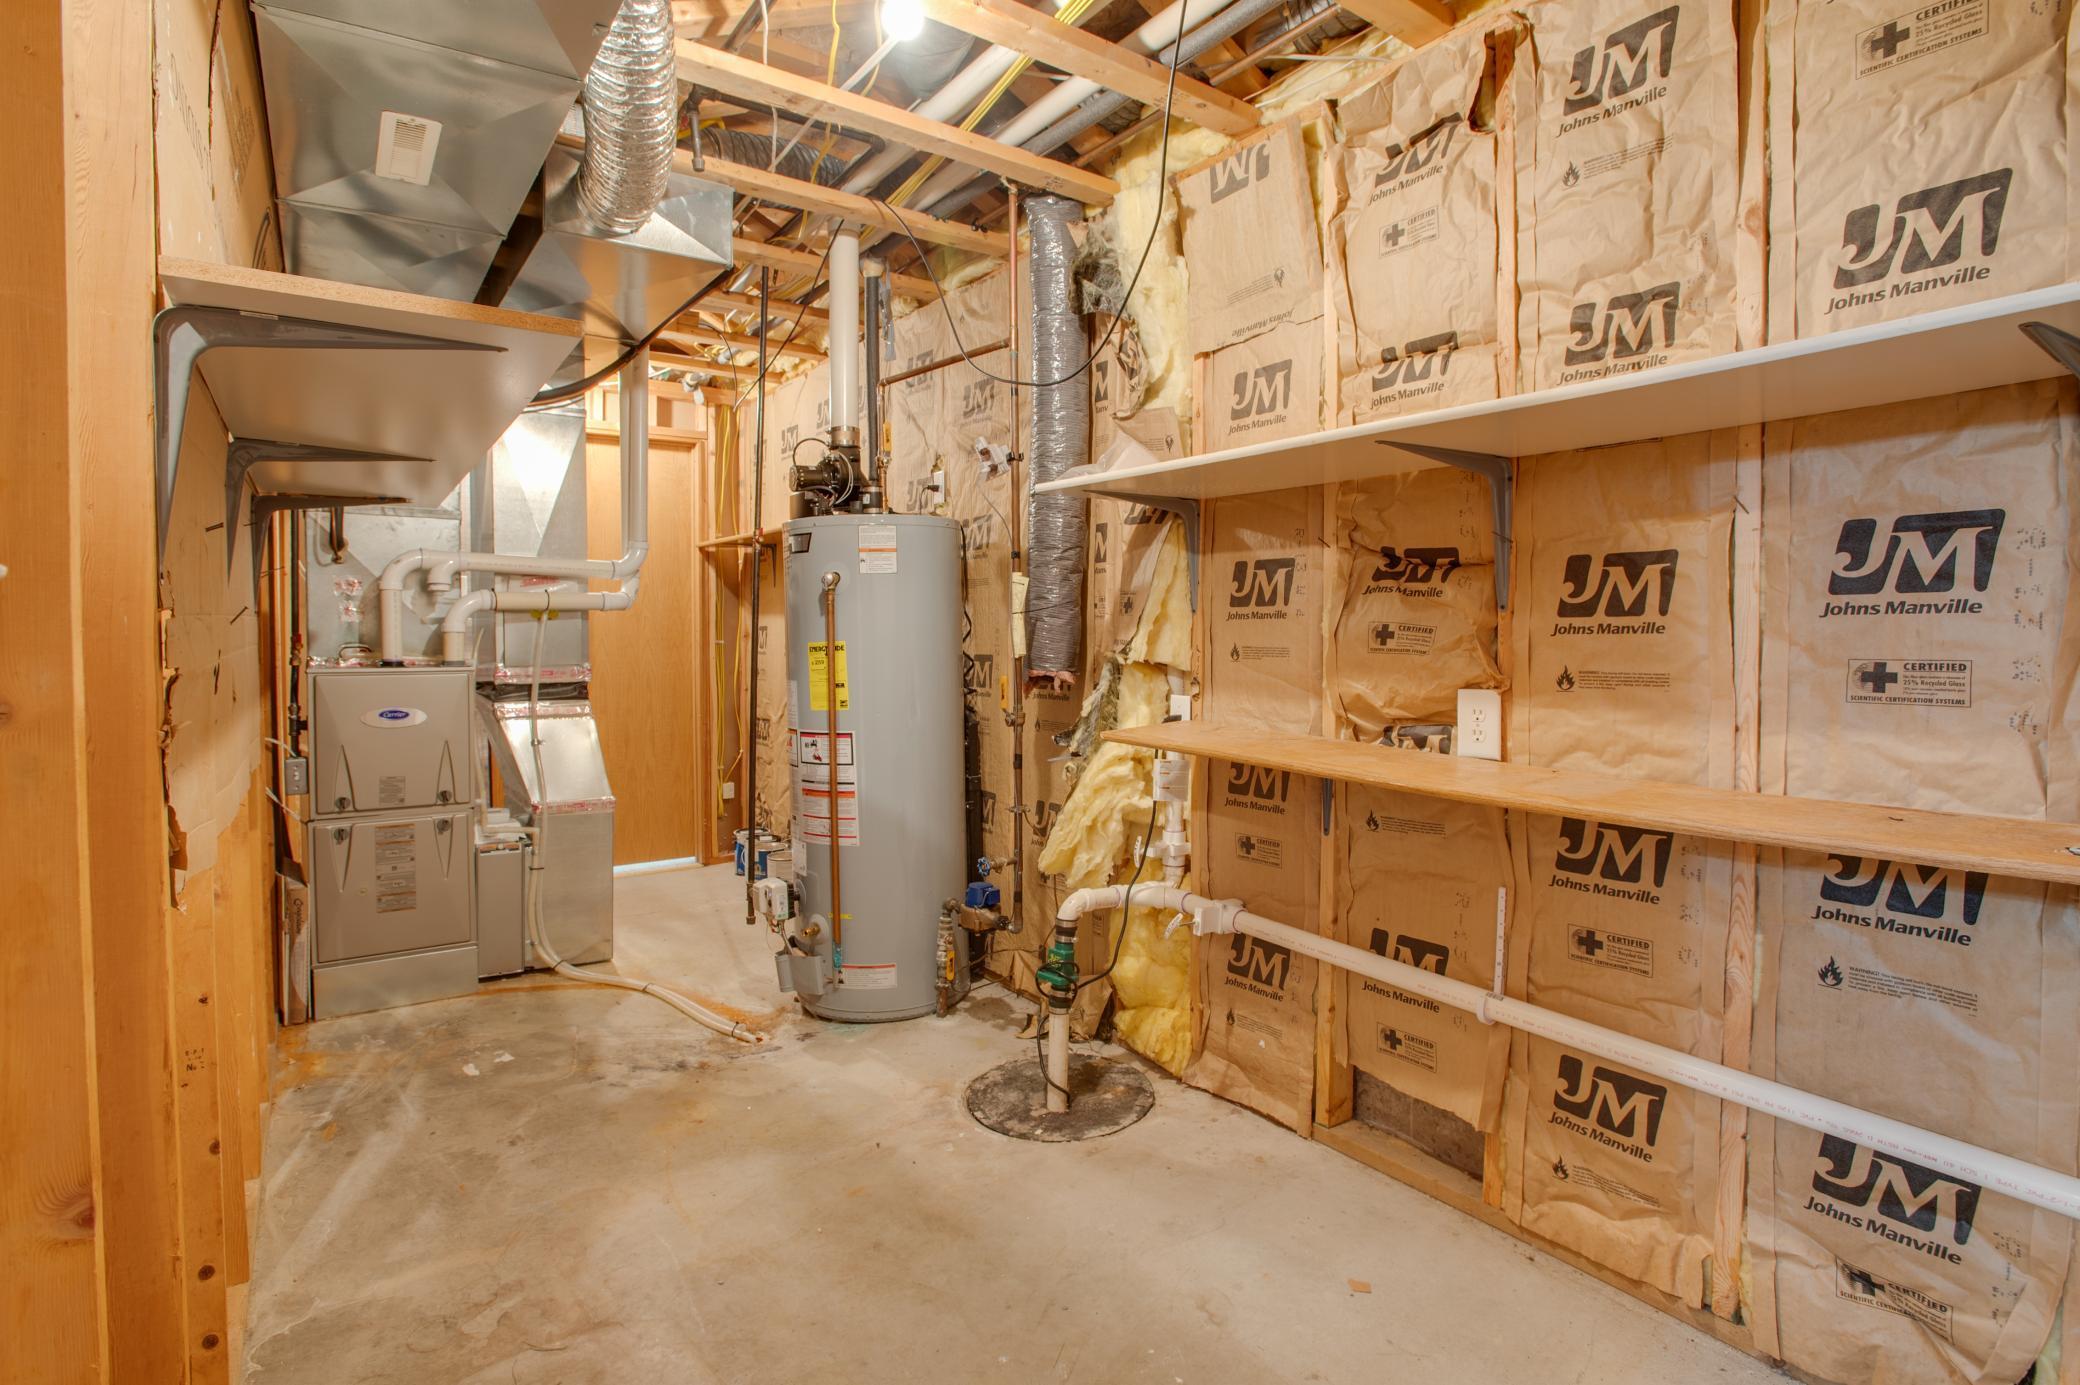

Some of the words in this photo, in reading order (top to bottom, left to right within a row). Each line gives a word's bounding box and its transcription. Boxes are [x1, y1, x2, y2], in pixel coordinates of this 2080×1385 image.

[1563, 5, 1680, 117] JM
[1860, 59, 1894, 76] SCIENTIFIC
[1896, 40, 1948, 63] CERTIFICATION
[1950, 27, 1983, 44] SYSTEMS
[1555, 112, 1601, 138] Johns
[1602, 85, 1668, 120] Manville
[1368, 184, 1397, 207] Johns
[1397, 164, 1444, 192] Manville
[1833, 168, 2013, 289] JM
[1824, 289, 1886, 315] Johns
[1889, 266, 1990, 298] Manville
[1565, 281, 1681, 366] JM
[1231, 358, 1293, 421] JM
[1557, 367, 1601, 385] Johns
[1603, 354, 1668, 377] Manville
[1368, 393, 1397, 410] Johns
[1397, 381, 1445, 402] Manville
[1228, 420, 1251, 436] Johns
[1251, 413, 1287, 430] Manville
[1828, 508, 2006, 595] JM
[1230, 558, 1295, 607] JM
[1362, 585, 1396, 595] Johns
[1395, 584, 1444, 598] Manville
[1557, 549, 1679, 618] JM
[1226, 610, 1250, 621] Johns
[1251, 610, 1287, 620] Manville
[1819, 602, 1881, 618] Johns
[1884, 599, 1983, 615] Manville
[1398, 625, 1434, 634] CERTIFIED
[1550, 623, 1594, 637] Johns
[1597, 622, 1666, 635] Manville
[1903, 662, 1967, 672] CERTIFIED
[1920, 680, 1947, 688] Recycled
[1885, 696, 1933, 704] CERTIFICATION
[1225, 797, 1249, 808] Johns
[1249, 801, 1286, 814] Manville
[1555, 817, 1674, 888] JM
[1549, 875, 1591, 893] Johns
[1592, 883, 1661, 904] Manville
[1607, 934, 1650, 949] CERTIFIED
[1811, 905, 1871, 927] Johns
[1874, 918, 1972, 946] Manville
[1228, 932, 1291, 991] JM
[1224, 976, 1248, 991] Johns
[1247, 983, 1284, 1002] Manville
[1362, 981, 1392, 998] Johns
[1391, 990, 1440, 1013] Manville
[1554, 1054, 1667, 1147] JM
[1548, 1112, 1588, 1136] Johns
[1588, 1128, 1653, 1163] Manville
[1812, 1133, 1981, 1245] JM
[1803, 1196, 1863, 1228] Johns
[1866, 1219, 1962, 1265] Manville
[1840, 1290, 1874, 1305] SCIENTIFIC
